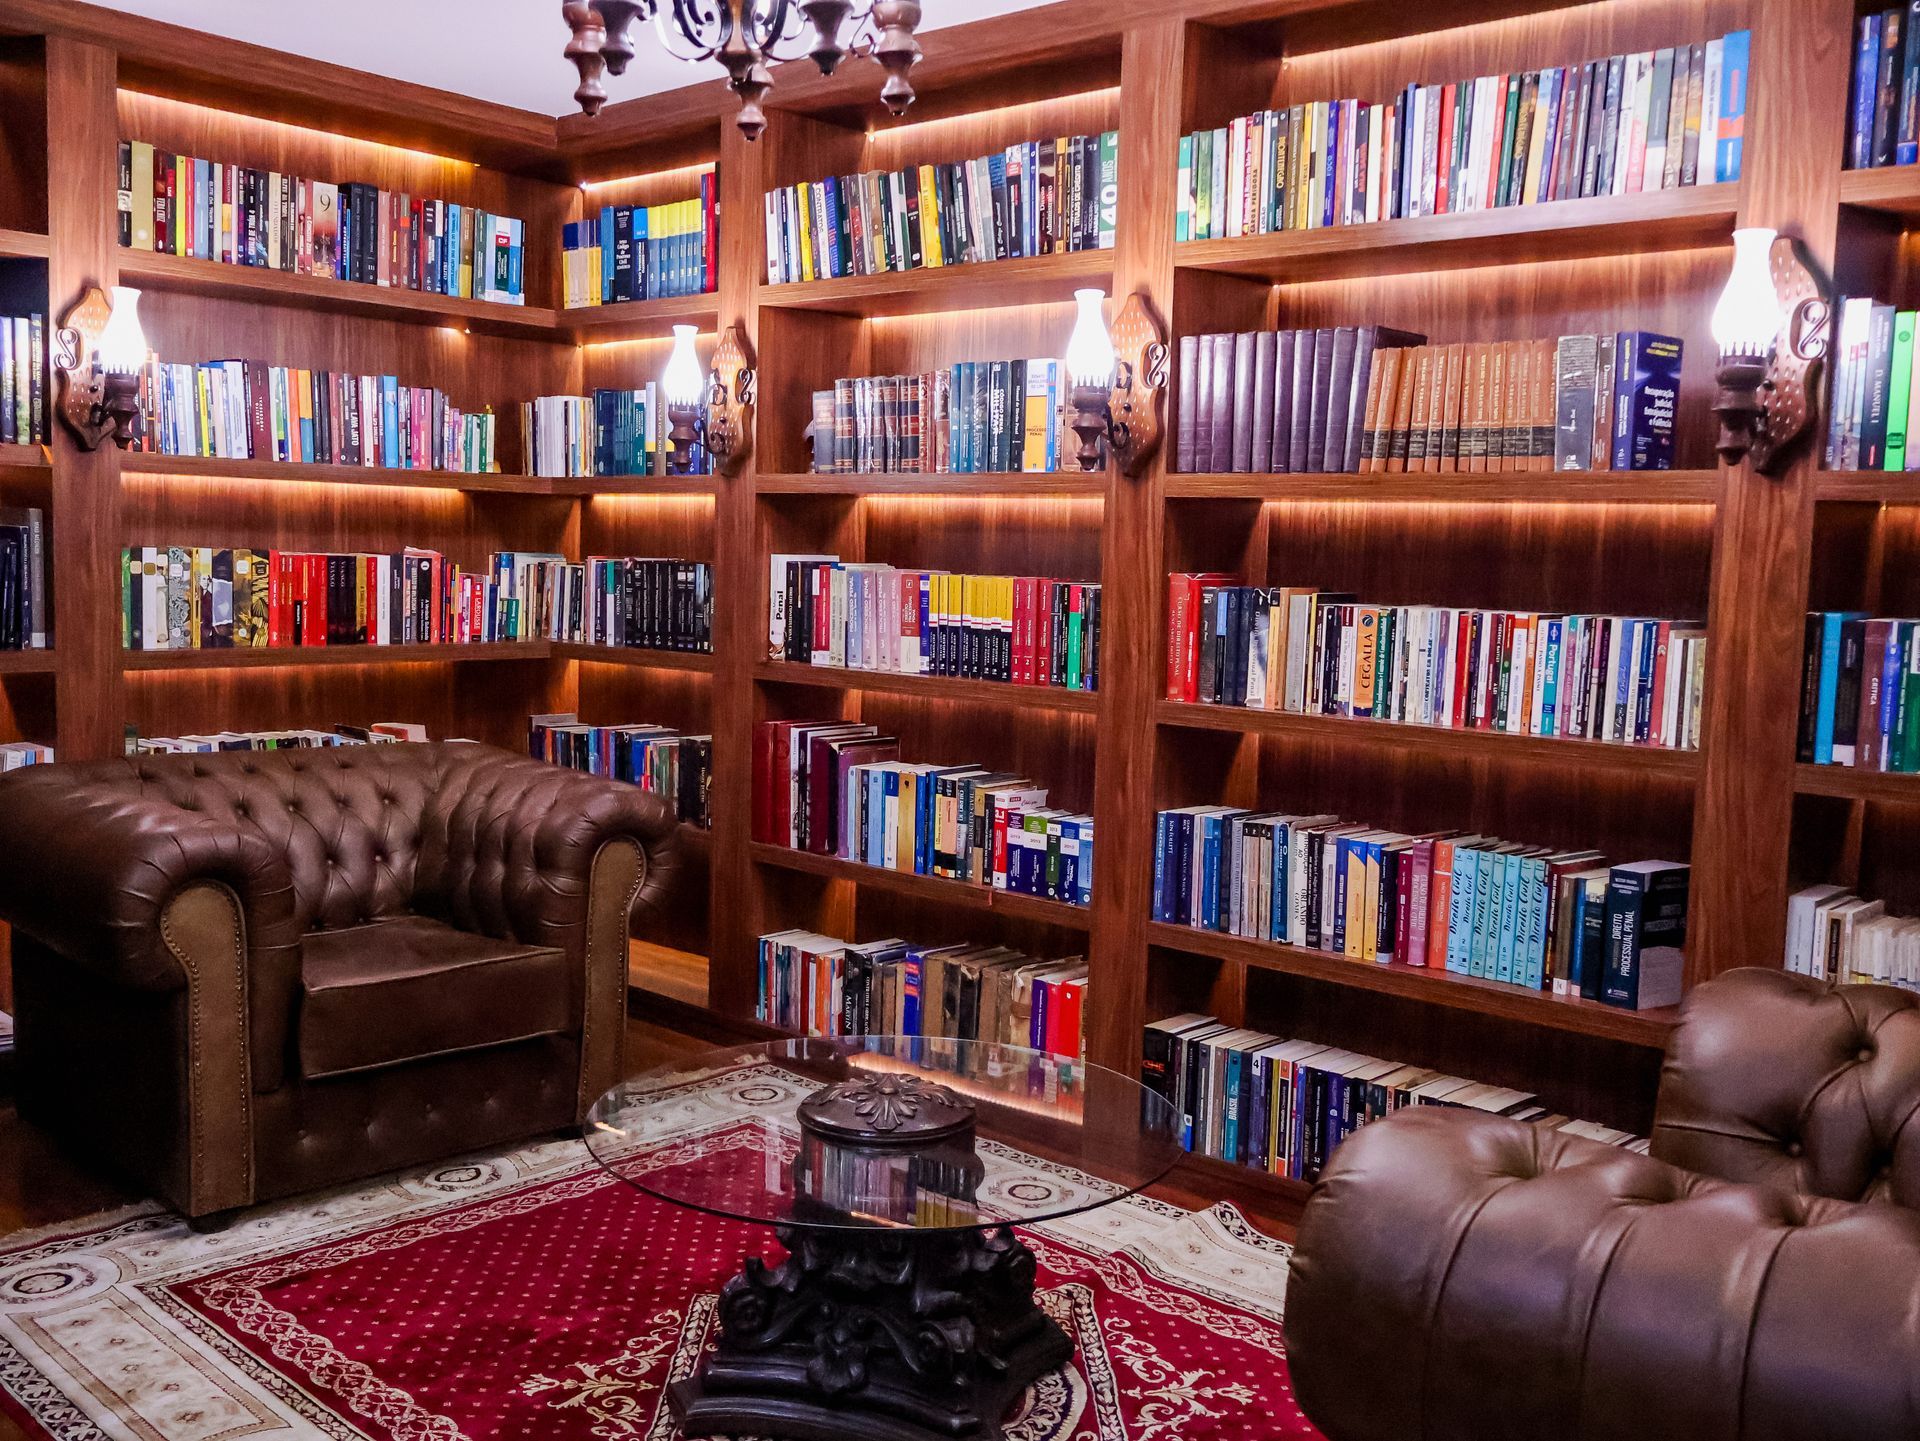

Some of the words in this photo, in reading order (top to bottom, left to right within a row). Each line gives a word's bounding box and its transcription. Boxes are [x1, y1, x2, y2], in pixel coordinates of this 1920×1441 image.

[350, 412, 359, 428] LAVA
[350, 429, 359, 446] JATO
[775, 590, 784, 621] Penal
[1361, 633, 1373, 689] CEGALLA
[1546, 644, 1558, 684] Portugal
[1612, 913, 1623, 940] DIREITO
[1624, 910, 1635, 933] PENAL
[1620, 933, 1633, 977] PROCESSUAL
[1253, 1058, 1259, 1069] 4
[1228, 1097, 1238, 1121] BRASIL
